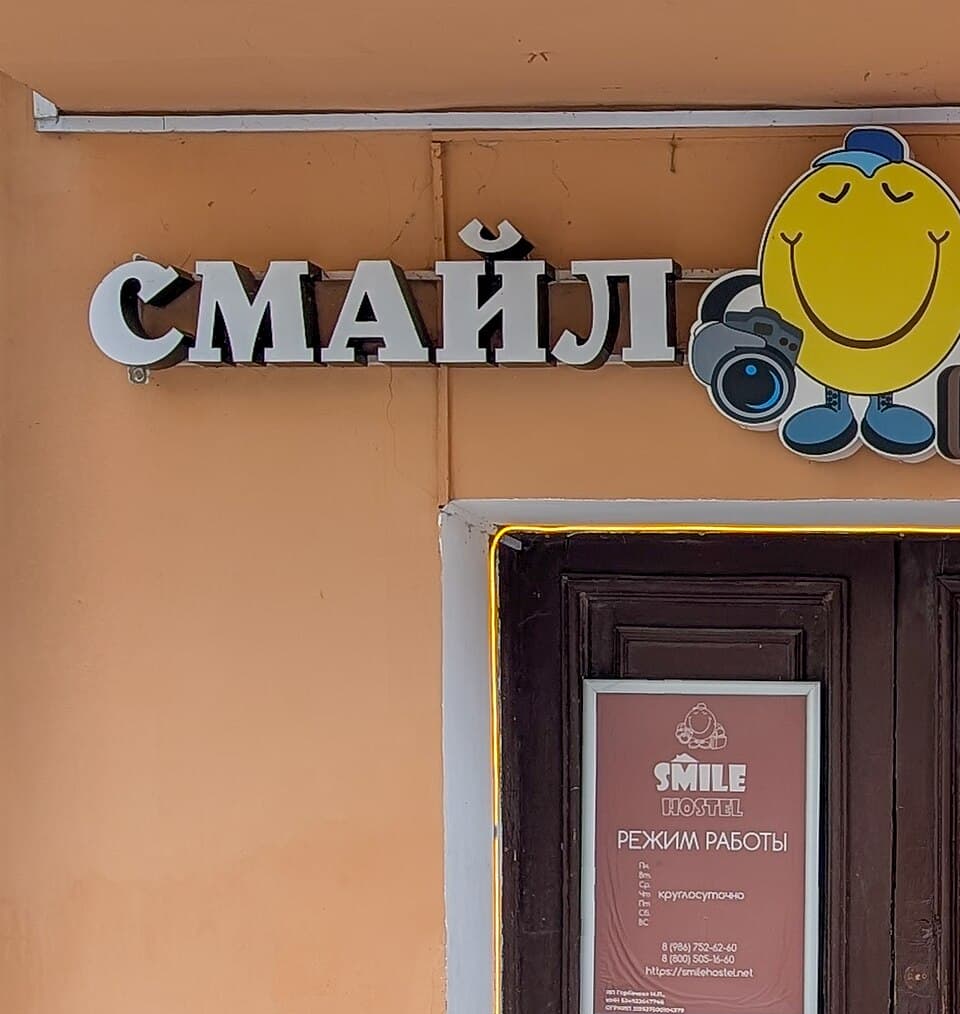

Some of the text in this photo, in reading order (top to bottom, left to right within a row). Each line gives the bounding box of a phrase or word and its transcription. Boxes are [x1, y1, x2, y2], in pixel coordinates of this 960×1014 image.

[88, 218, 680, 367] СМАЙЛ
[653, 762, 747, 792] SMILE
[661, 797, 744, 817] HOSTEL
[616, 829, 788, 852] РЕЖИМ РАБОТЫ
[658, 890, 745, 902] круглосуточно
[661, 942, 668, 952] 8
[692, 942, 738, 953] 752-62-60
[661, 954, 735, 965] 8 (800) 505-16-60
[645, 966, 754, 978] https://smilehostel.net
